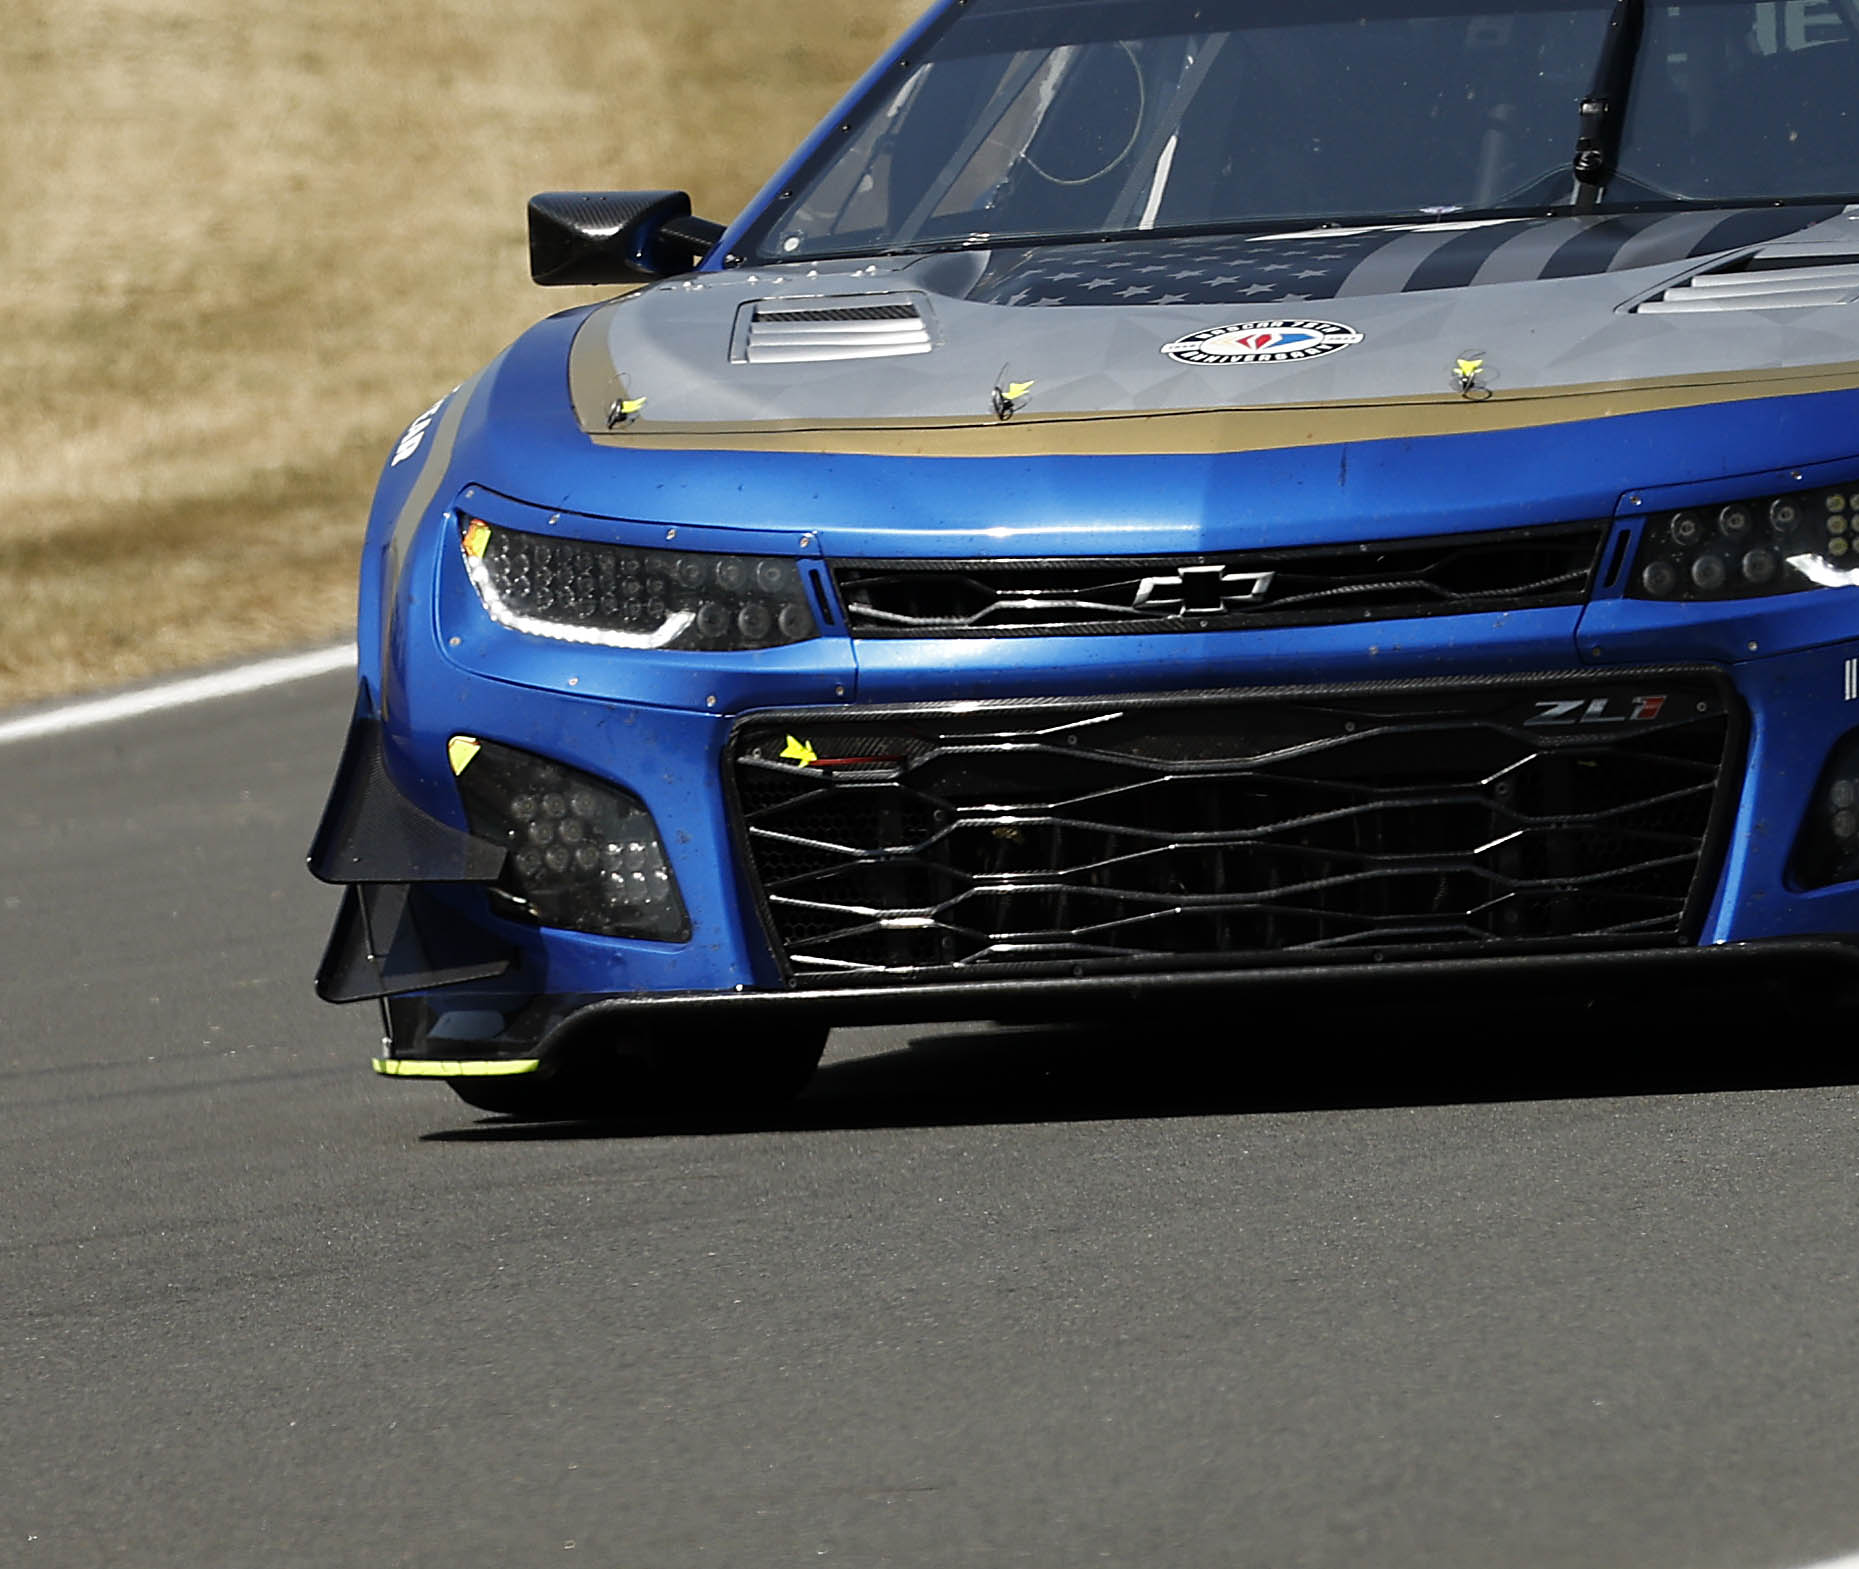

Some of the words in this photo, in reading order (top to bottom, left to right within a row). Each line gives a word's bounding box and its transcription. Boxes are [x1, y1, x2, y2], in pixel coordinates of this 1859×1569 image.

[1195, 320, 1284, 340] NASCAR
[1180, 343, 1334, 364] ANNIVERSARY
[1523, 694, 1668, 727] ZL1
